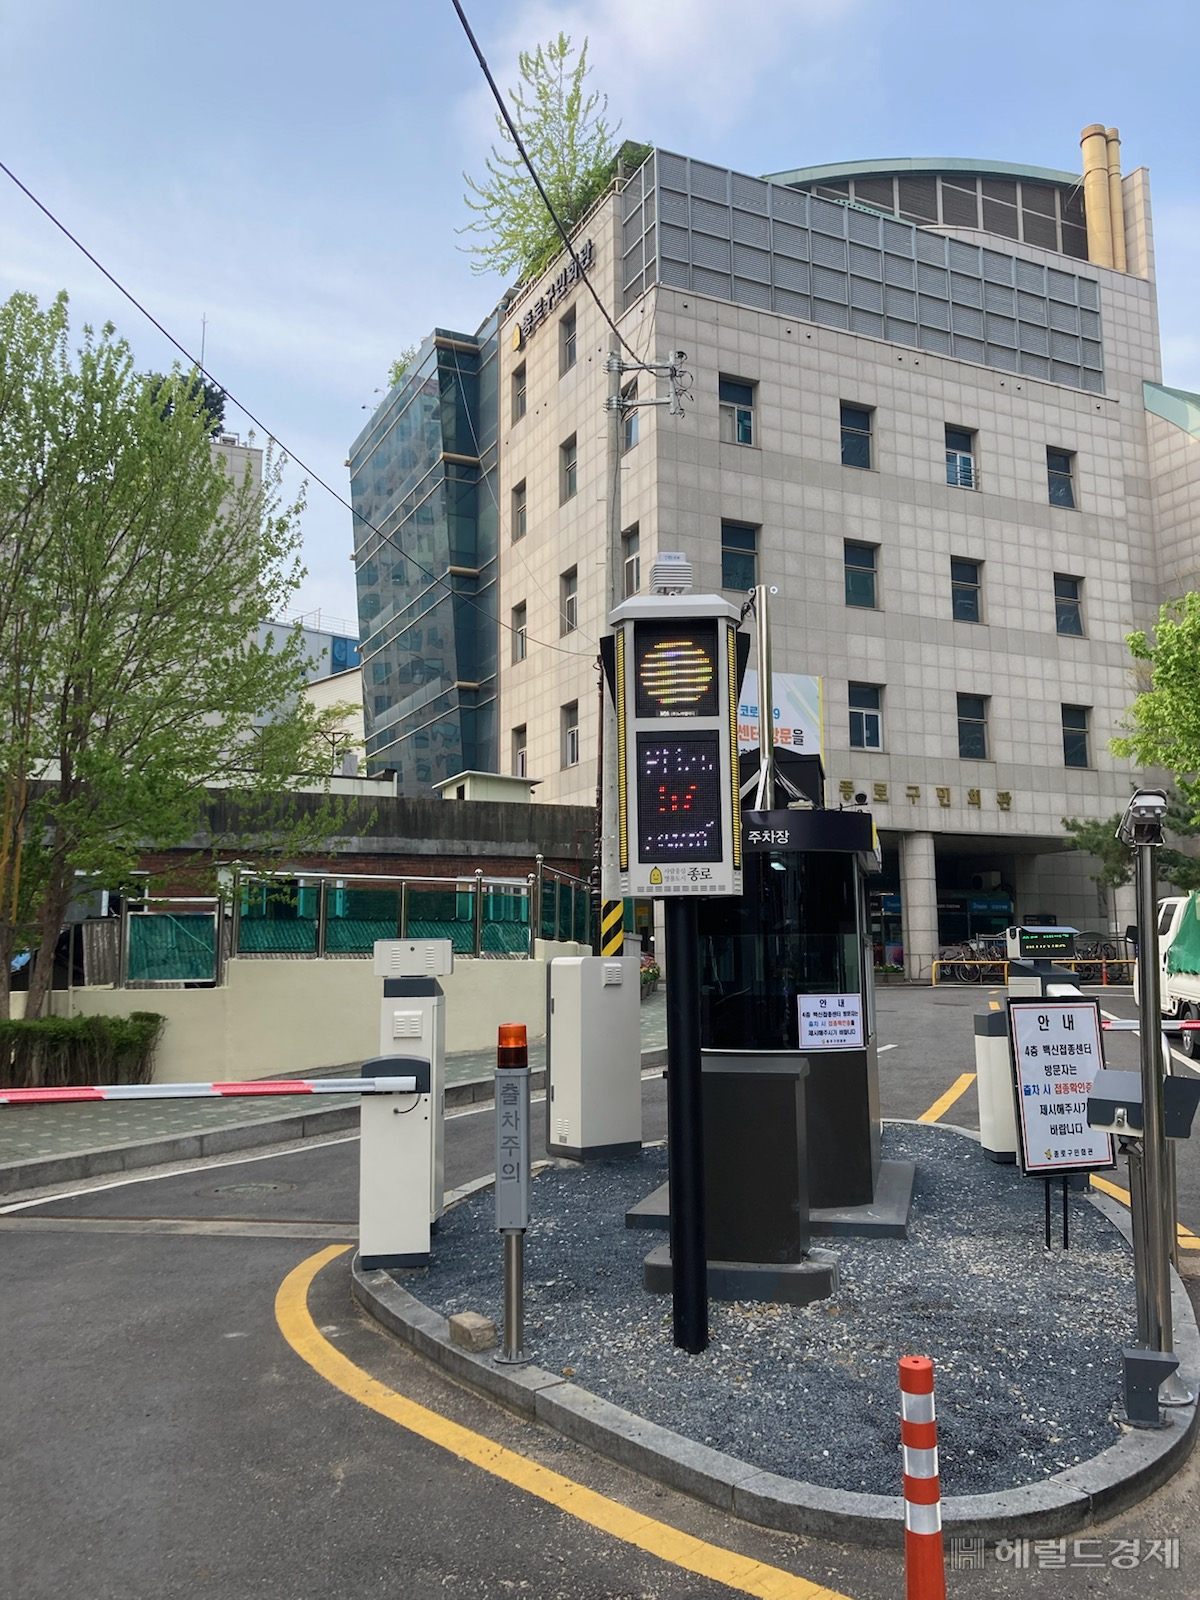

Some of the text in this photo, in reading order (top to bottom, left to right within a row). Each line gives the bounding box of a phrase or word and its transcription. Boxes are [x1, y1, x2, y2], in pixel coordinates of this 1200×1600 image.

[521, 238, 595, 337] 종로구민회관
[739, 704, 781, 720] 코로9
[839, 780, 1012, 811] 종로구민회관
[747, 830, 790, 845] 주차장
[687, 867, 713, 882] 종로
[819, 999, 845, 1008] 안 내
[1037, 1013, 1075, 1032] 안 내
[1024, 1043, 1092, 1057] 4층 백신접종센터
[1044, 1063, 1077, 1077] 방문자는
[1023, 1084, 1040, 1097] 출차
[1043, 1084, 1051, 1096] 시
[500, 1083, 520, 1183] 출차주의
[1050, 1122, 1083, 1136] 바랍니다
[1054, 1148, 1094, 1159] 종로구민회관
